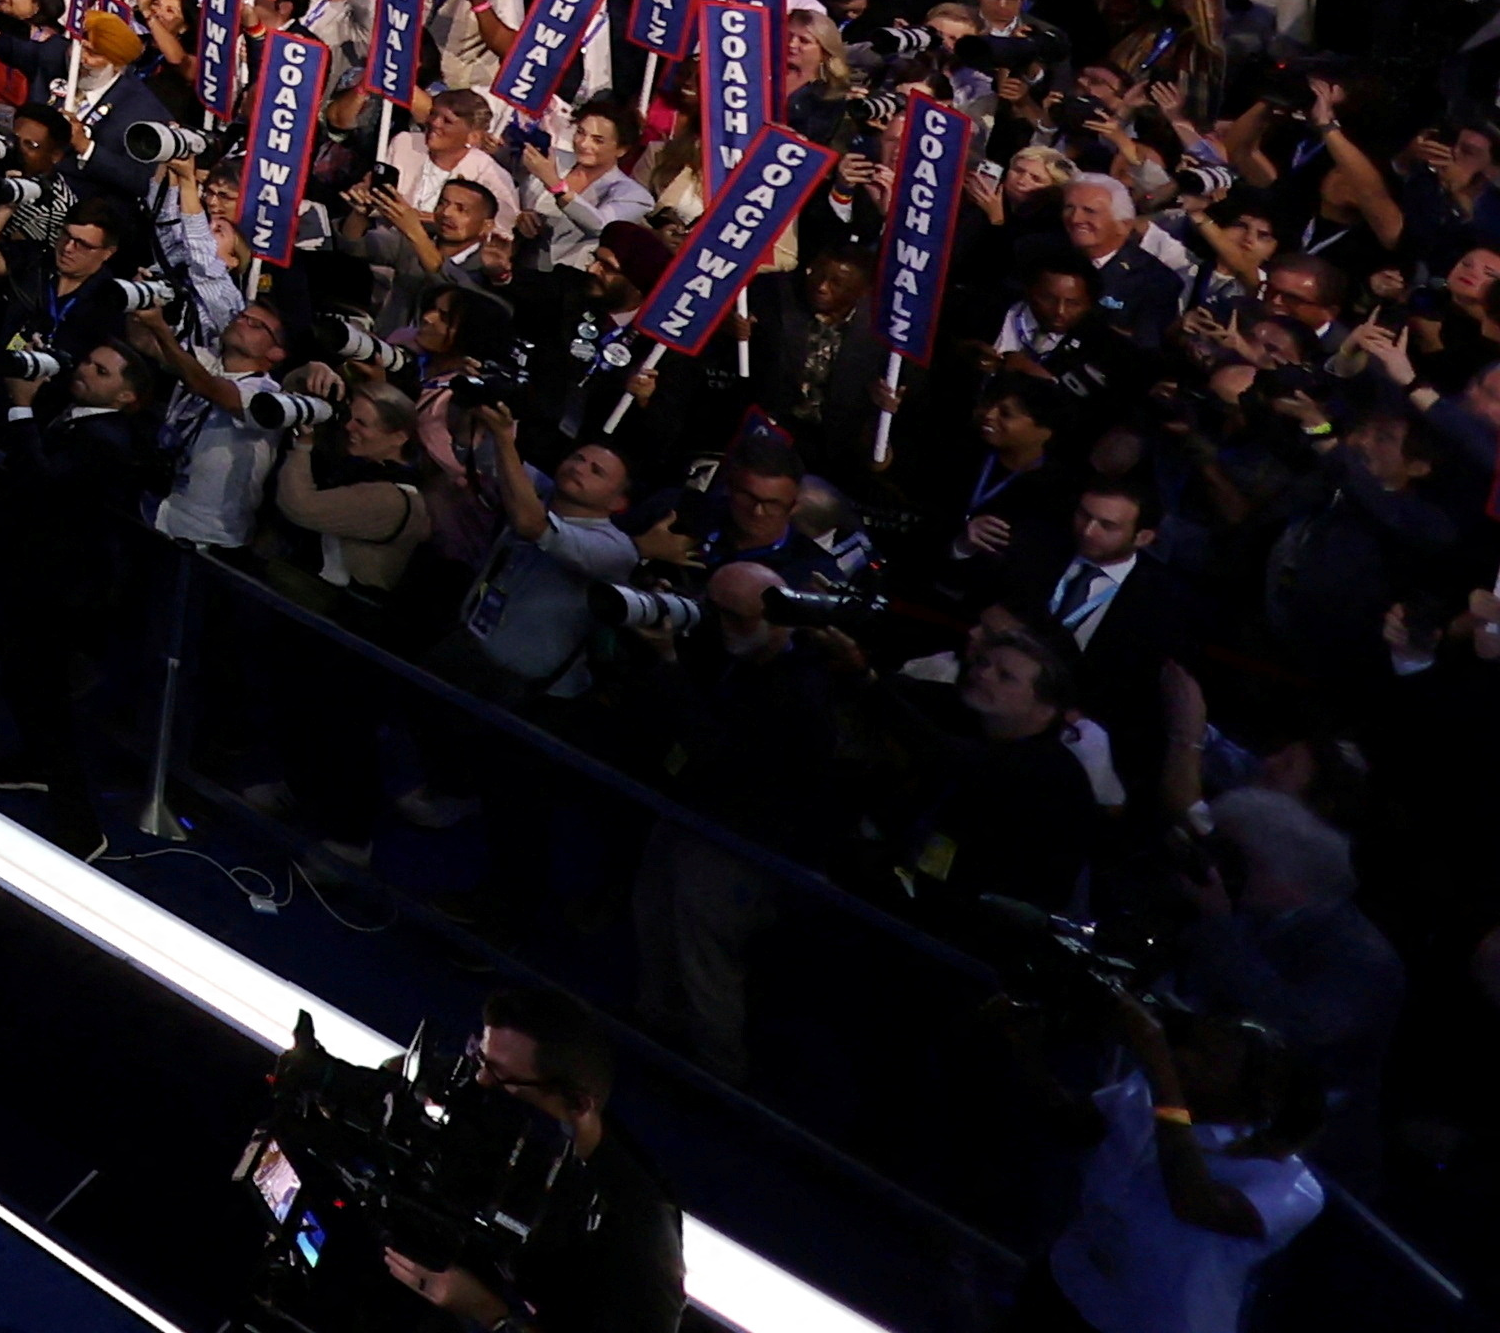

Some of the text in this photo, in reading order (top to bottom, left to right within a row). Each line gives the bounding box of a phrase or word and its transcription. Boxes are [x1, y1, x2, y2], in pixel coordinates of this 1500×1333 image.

[252, 42, 307, 249] COACH WALZ
[383, 4, 409, 91] WALZ
[659, 142, 808, 338] COACH WALZ
[888, 108, 947, 342] COACH WALZ
